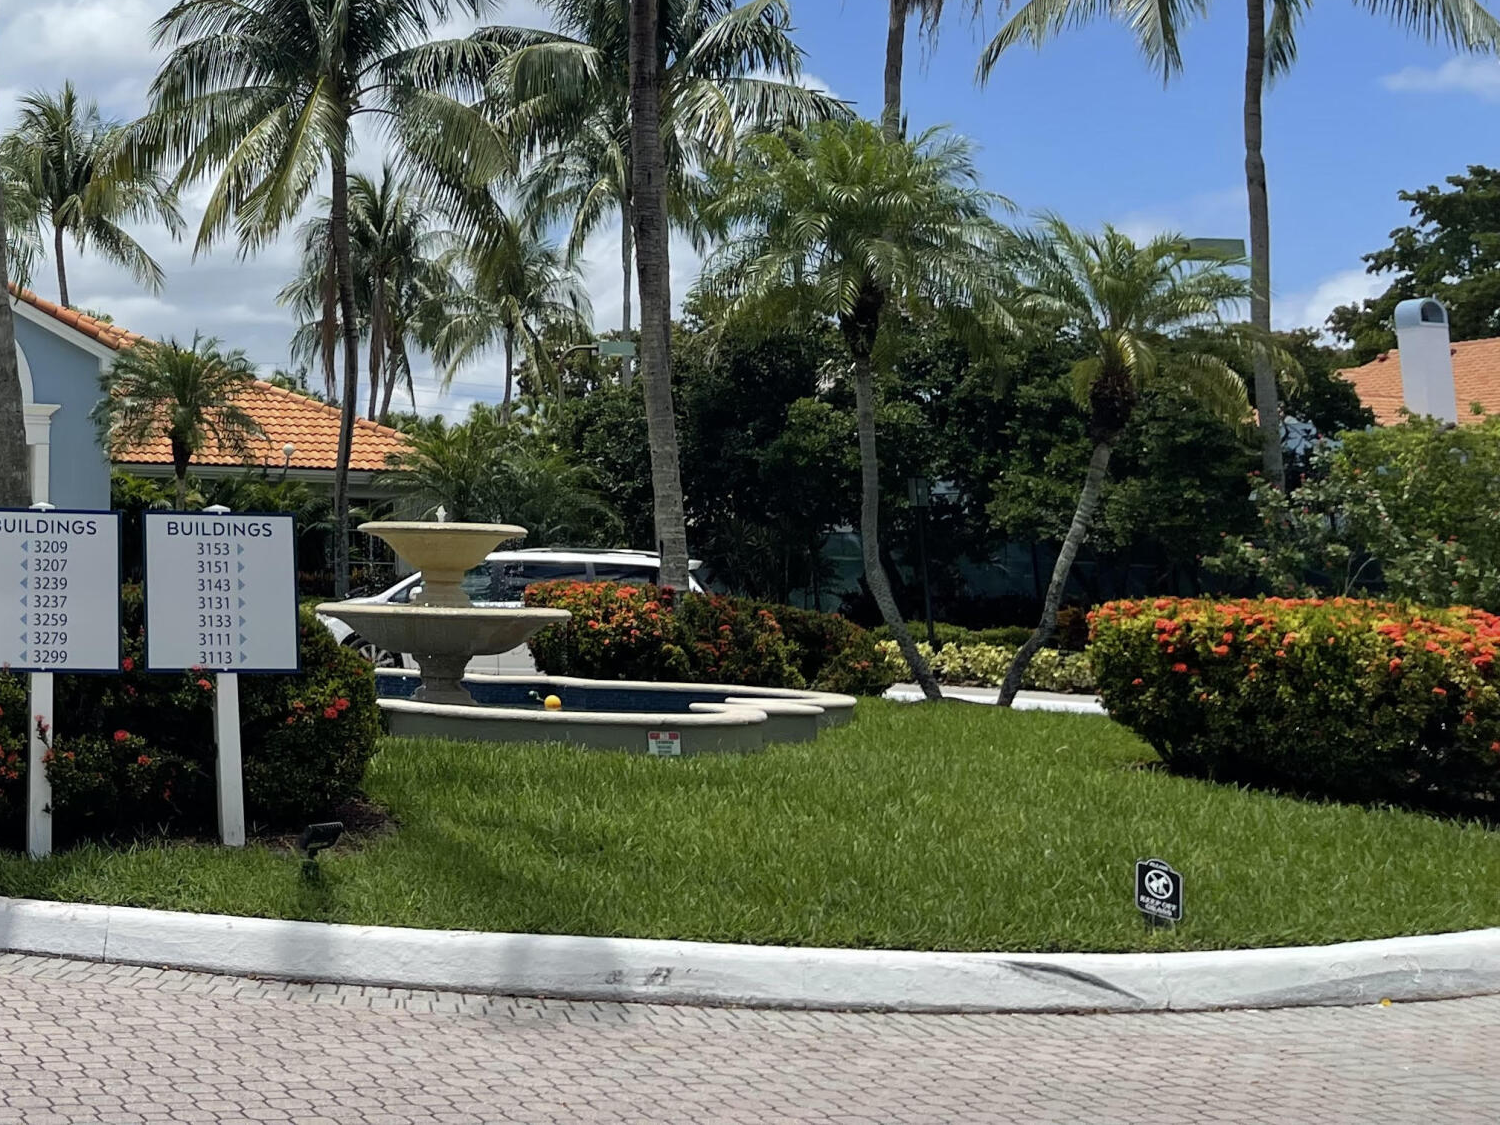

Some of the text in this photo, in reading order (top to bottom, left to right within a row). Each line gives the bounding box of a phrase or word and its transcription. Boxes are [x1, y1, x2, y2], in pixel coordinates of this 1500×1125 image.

[167, 521, 272, 537] BUILDINGS
[34, 540, 67, 554] 3209
[197, 542, 229, 555] 3153
[34, 558, 67, 571] 3207
[198, 560, 228, 573] 3151
[34, 577, 67, 590] 3239
[198, 579, 230, 592] 3143
[34, 595, 67, 608] 3237
[198, 596, 229, 609] 3131
[33, 613, 67, 627] 3259
[199, 614, 231, 628] 3133
[34, 631, 67, 645] 3279
[199, 633, 230, 646] 3111
[33, 650, 67, 663] 3299
[199, 651, 232, 664] 3113
